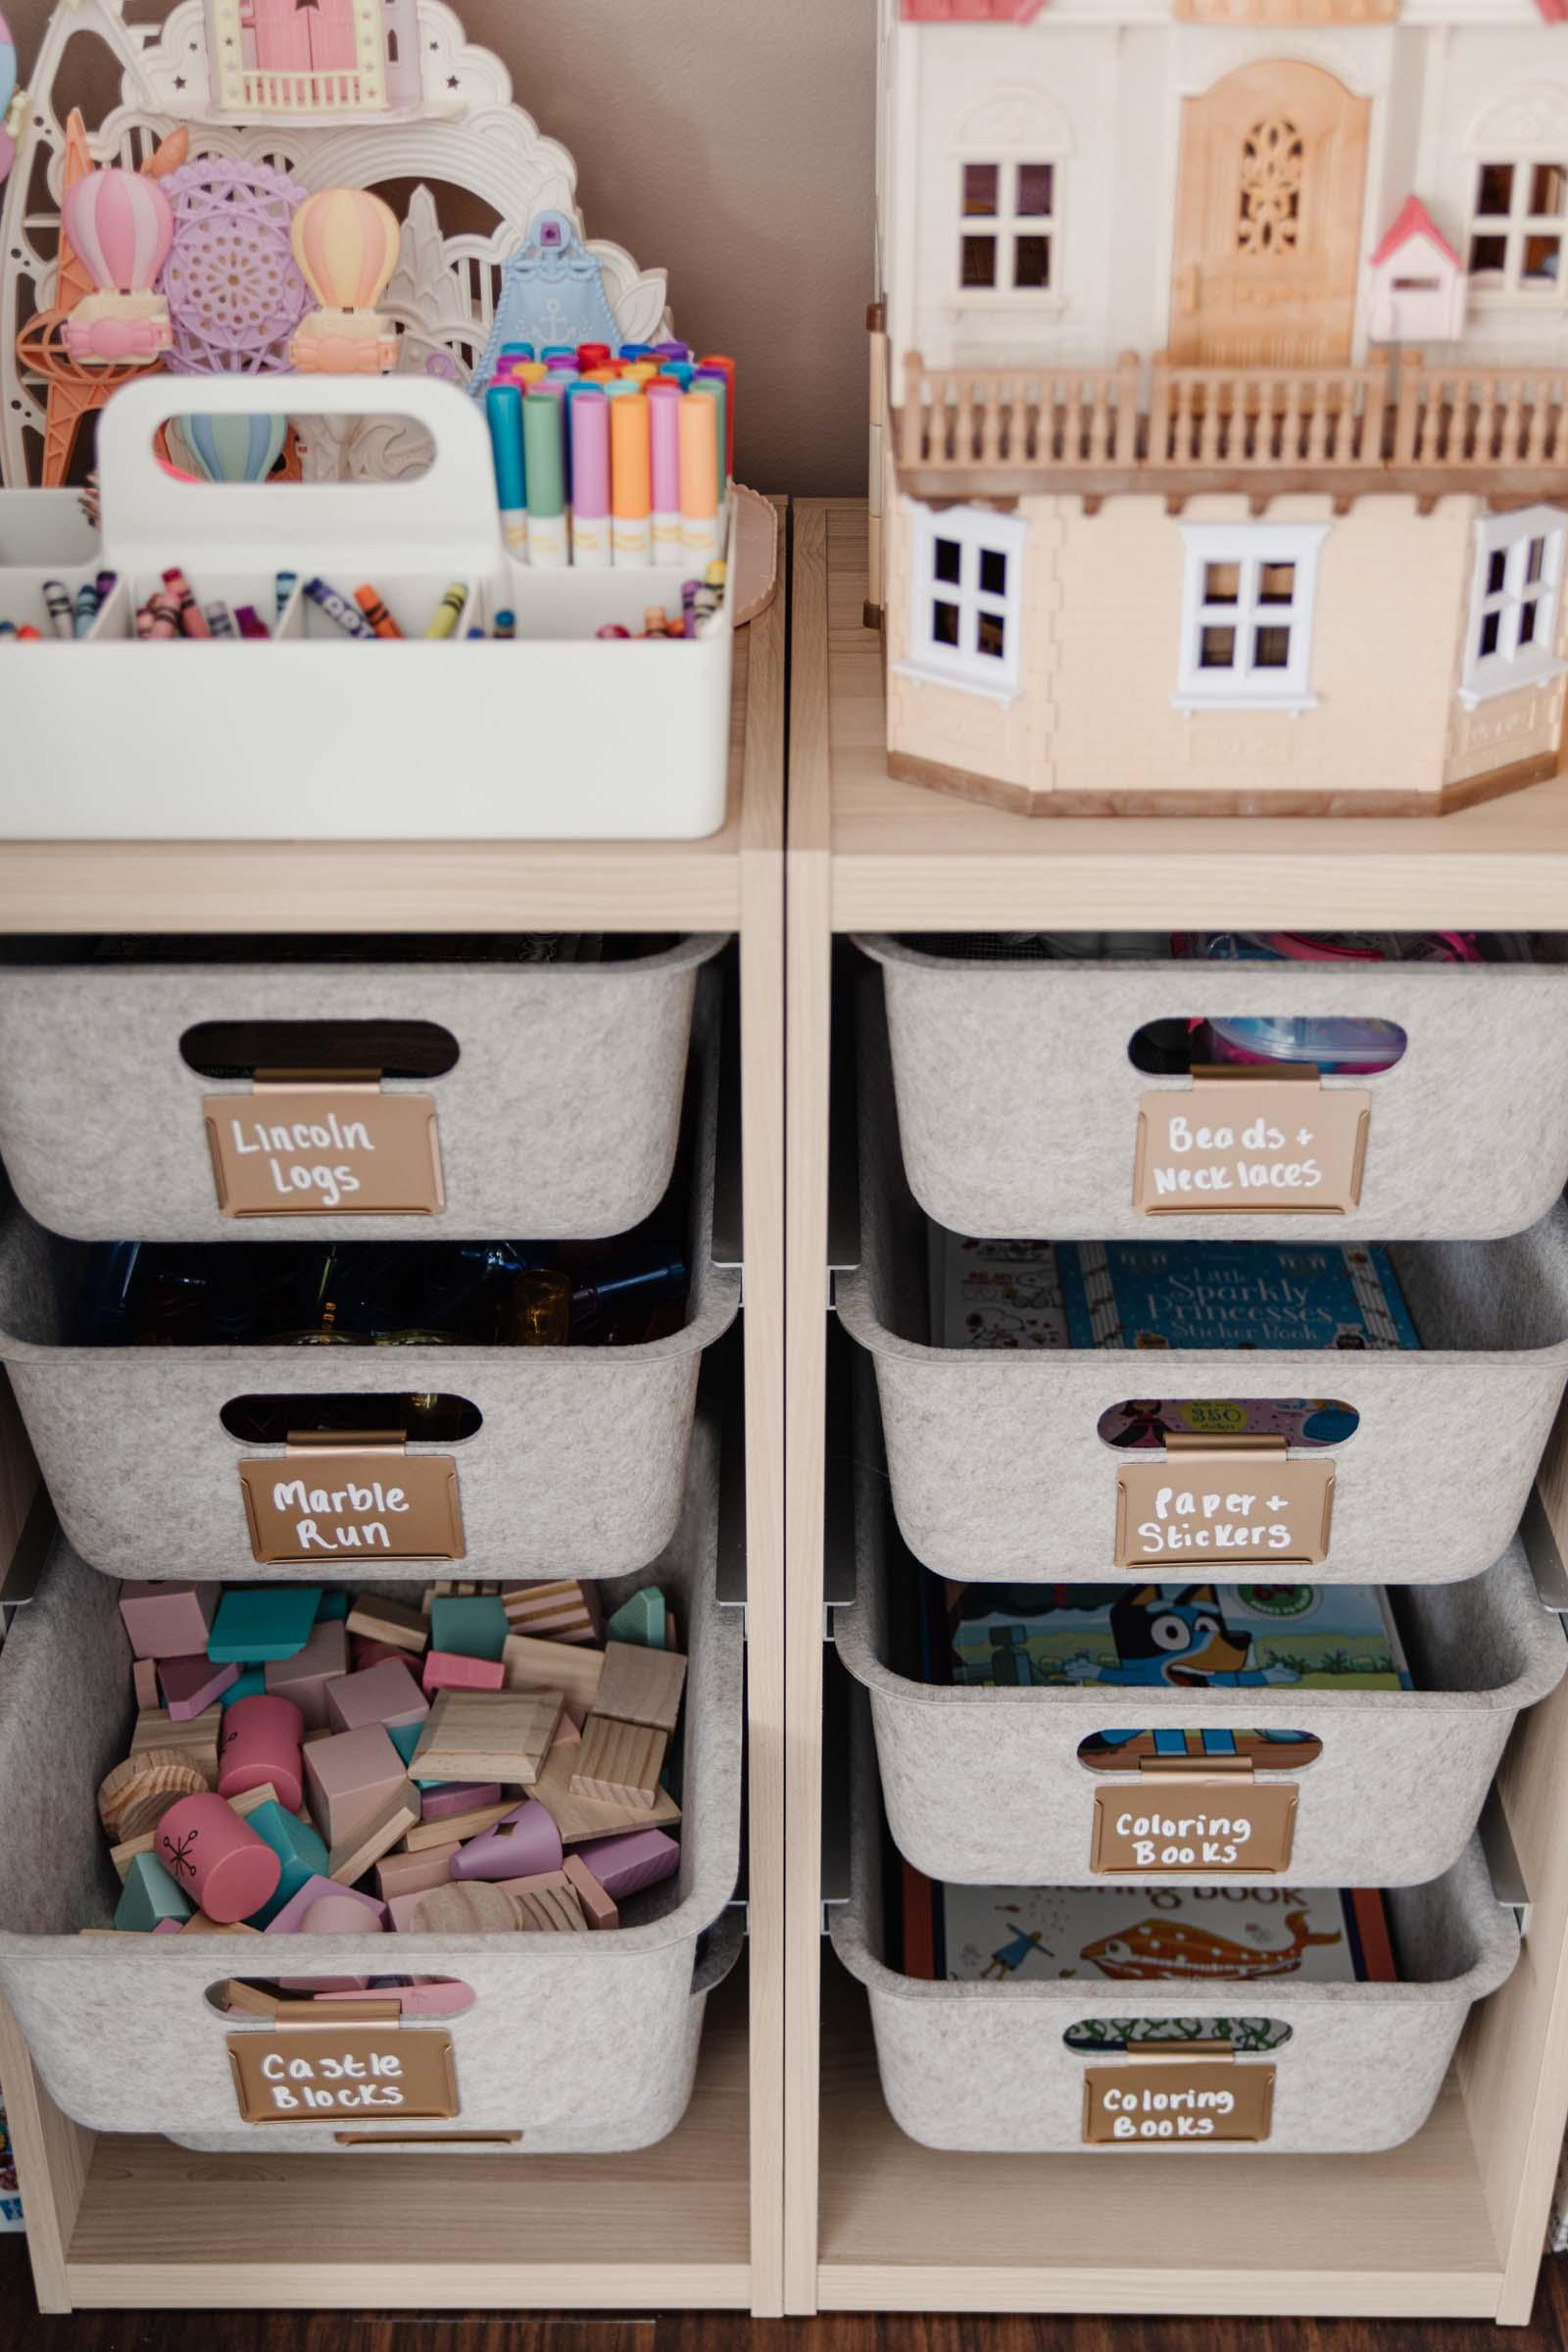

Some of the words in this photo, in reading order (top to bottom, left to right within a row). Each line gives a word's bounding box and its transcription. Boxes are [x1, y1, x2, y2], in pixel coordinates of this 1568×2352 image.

[231, 1112, 375, 1153] Lincoln
[1168, 1115, 1287, 1152] Beads
[270, 1158, 361, 1206] Logs
[1168, 1274, 1309, 1305] Sparkly
[1148, 1293, 1333, 1323] Princesses
[1171, 1321, 1256, 1340] Sticker
[272, 1480, 410, 1514] Marble
[1154, 1487, 1256, 1519] Paper
[295, 1518, 391, 1549] Run
[1115, 1813, 1251, 1843] Coloring
[262, 2052, 403, 2080] Castle
[1102, 2088, 1235, 2114] Coloring
